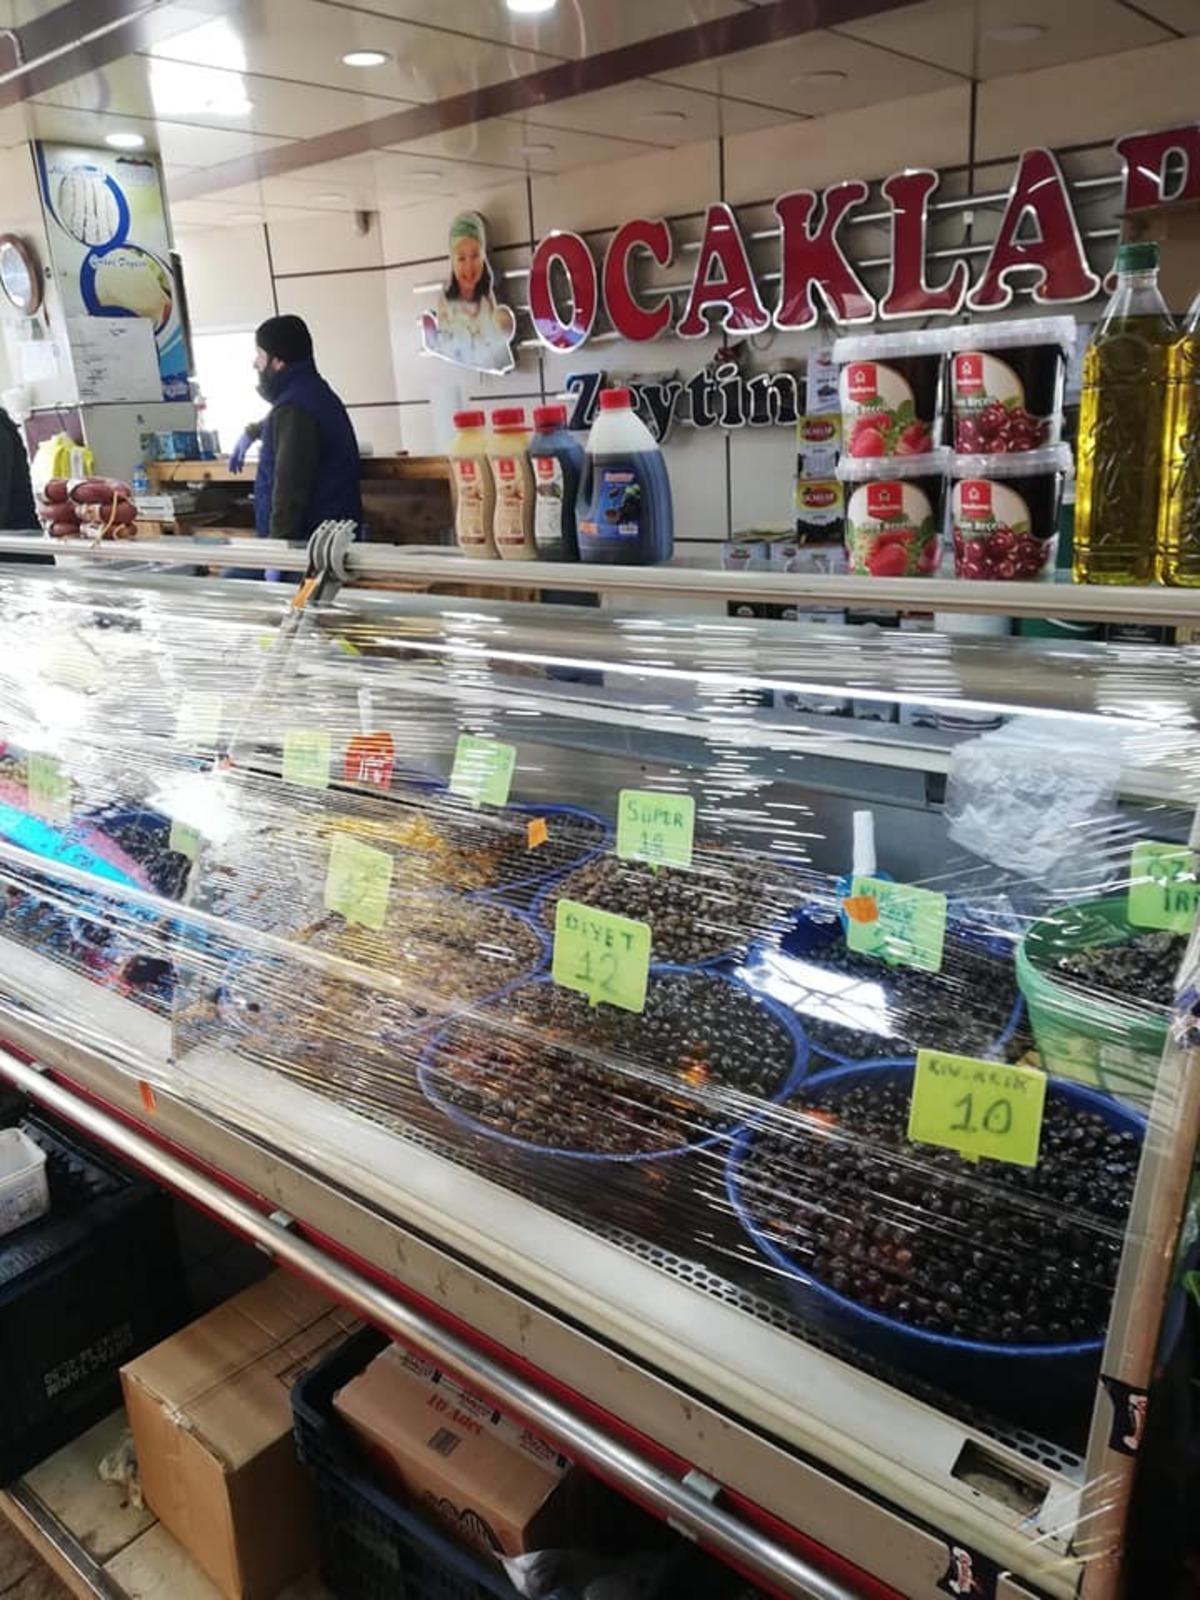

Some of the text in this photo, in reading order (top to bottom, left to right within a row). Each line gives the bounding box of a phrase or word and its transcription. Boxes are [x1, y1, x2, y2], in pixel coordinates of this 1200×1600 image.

[565, 362, 801, 444] Zytin
[574, 948, 619, 997] 12
[948, 1092, 1013, 1135] 10
